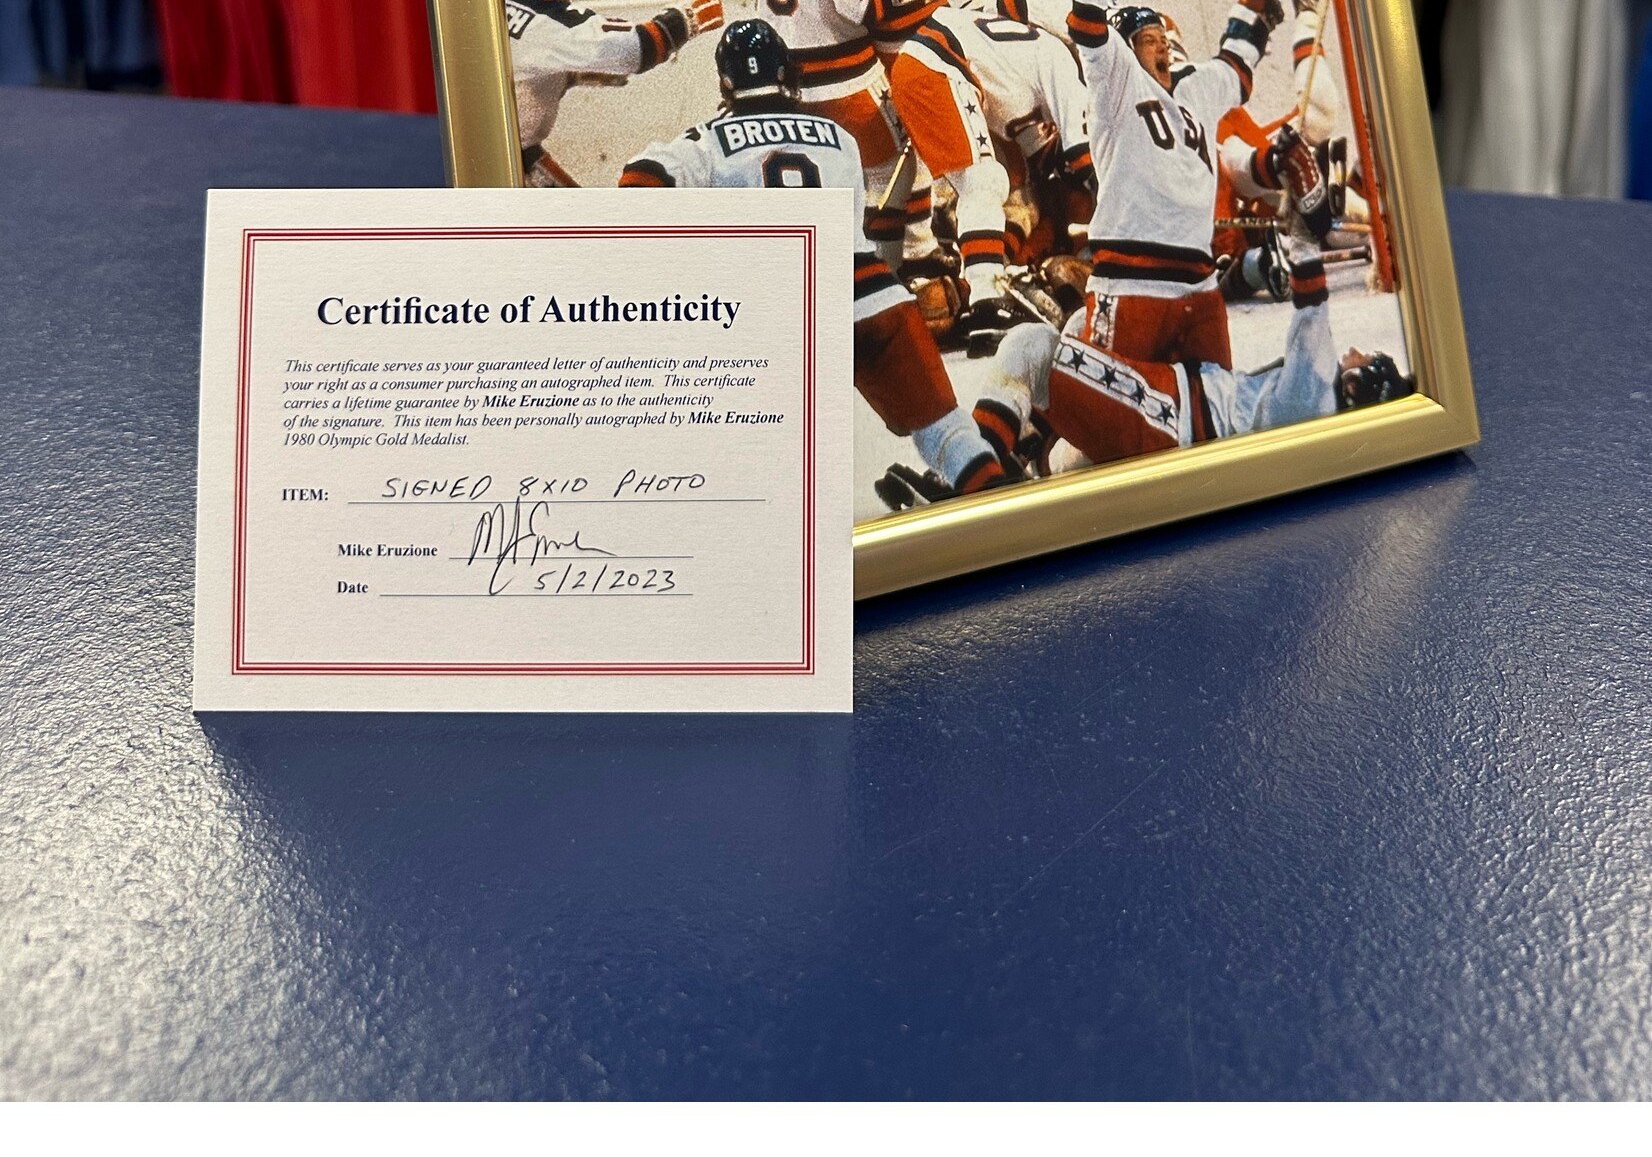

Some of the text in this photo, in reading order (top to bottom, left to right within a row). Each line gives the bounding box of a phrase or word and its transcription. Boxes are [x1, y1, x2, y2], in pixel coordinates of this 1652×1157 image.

[748, 57, 758, 74] 9
[723, 119, 837, 152] BROTEN
[317, 293, 741, 329] Certificate of Authenticity
[286, 356, 769, 375] This certificate serves as your guaranteed letter of authenticity and preserves
[283, 374, 756, 394] your right as a consumer purchasing an autographed item. This certificate
[283, 393, 714, 411] carries a lifetime guarantee by Mike Eruzione as to the authenticity
[283, 411, 784, 430] of the signature. This item has been personally autographed by Mike Eruzione
[283, 432, 470, 448] 1980 Olympic Gold Medalist.
[382, 475, 492, 500] SIGNED
[614, 469, 706, 498] PHOTO
[282, 488, 329, 501] ITEM:
[337, 544, 438, 557] Mike Eruzione
[337, 581, 369, 594] Date
[534, 563, 676, 593] 5/2/2023
